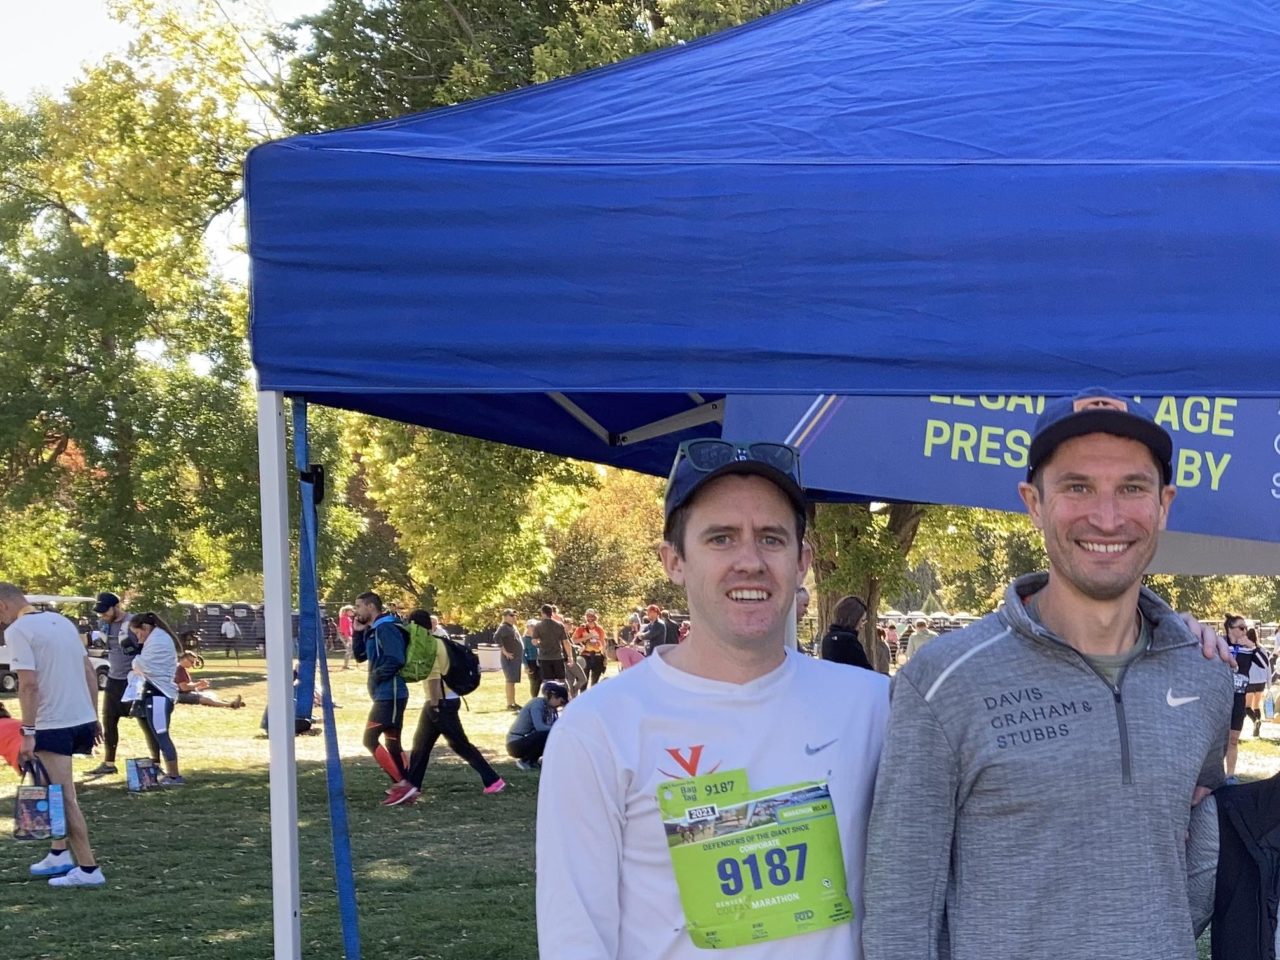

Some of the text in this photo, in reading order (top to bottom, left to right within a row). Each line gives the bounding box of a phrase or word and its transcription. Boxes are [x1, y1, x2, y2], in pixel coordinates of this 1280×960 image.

[1175, 447, 1232, 491] BY
[983, 687, 1044, 711] DAVIS
[990, 700, 1094, 730] GRAHAM &
[996, 723, 1070, 749] STUBBS
[704, 780, 735, 796] 9187
[690, 806, 714, 819] 2021
[702, 837, 746, 851] DEFENDERS
[756, 832, 770, 841] THE
[770, 828, 791, 839] GIANT
[791, 823, 810, 834] SHOE
[716, 842, 808, 896] 9187
[751, 892, 800, 910] MARATHON
